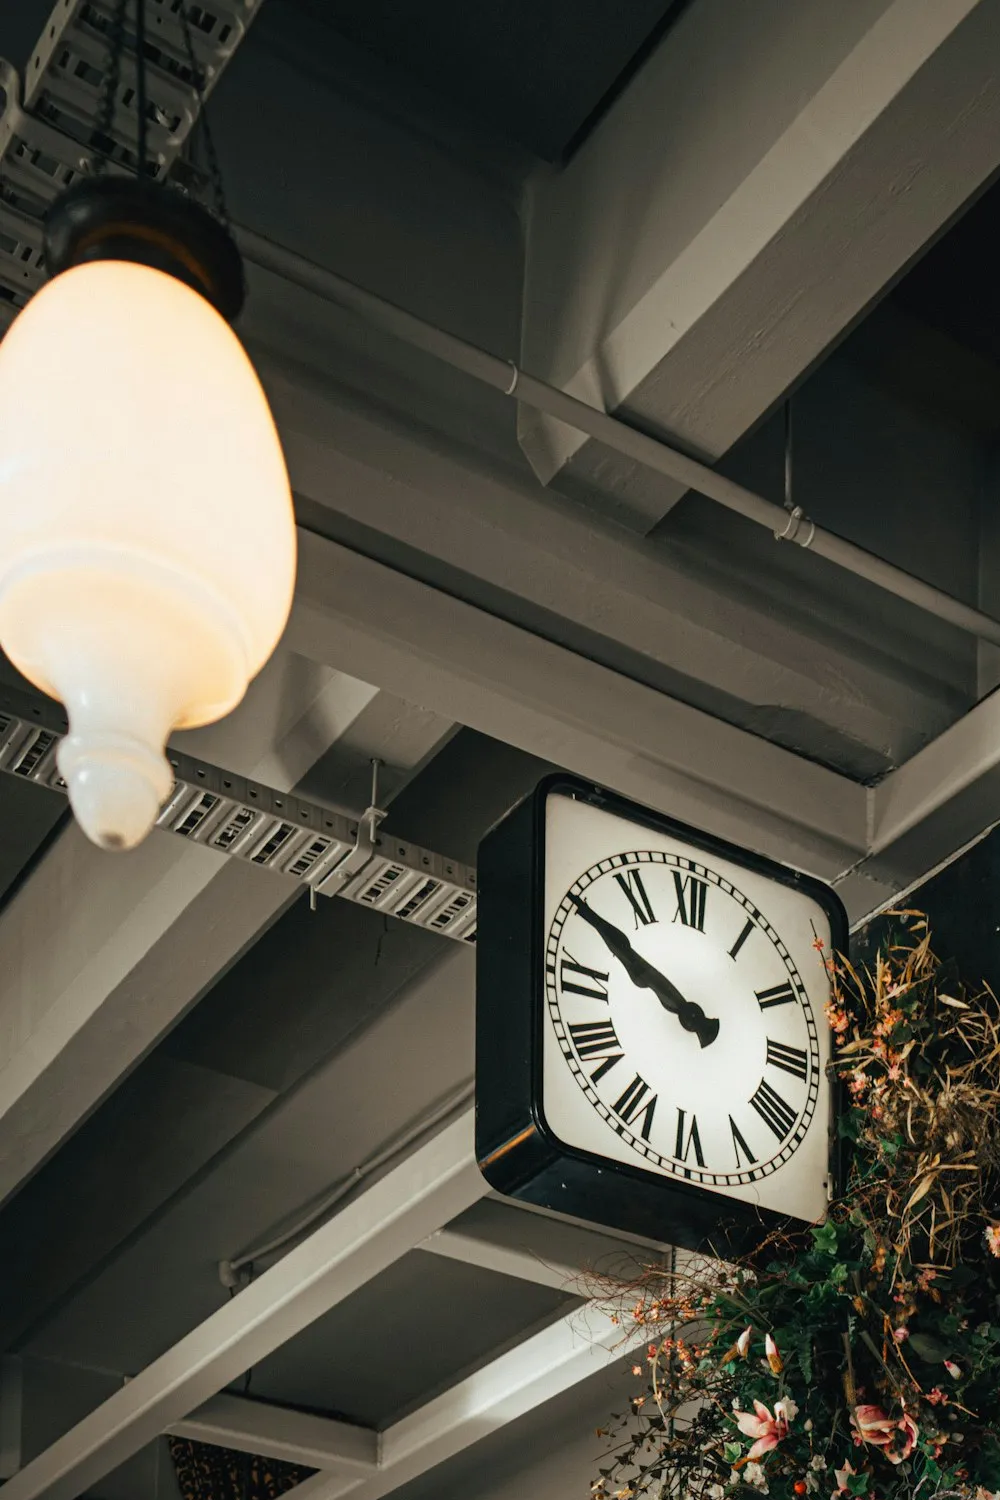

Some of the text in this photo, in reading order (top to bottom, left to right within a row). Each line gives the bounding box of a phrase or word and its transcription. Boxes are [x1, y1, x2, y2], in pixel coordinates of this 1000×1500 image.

[612, 868, 659, 930] XI
[670, 869, 710, 935] XII
[726, 916, 757, 962] I
[561, 946, 609, 1005] IX
[753, 978, 799, 1013] II
[567, 1017, 625, 1087] VIII
[765, 1036, 807, 1084] III
[610, 1072, 658, 1144] VII
[673, 1107, 708, 1169] VI
[748, 1077, 799, 1144] IIII
[728, 1114, 759, 1169] V
